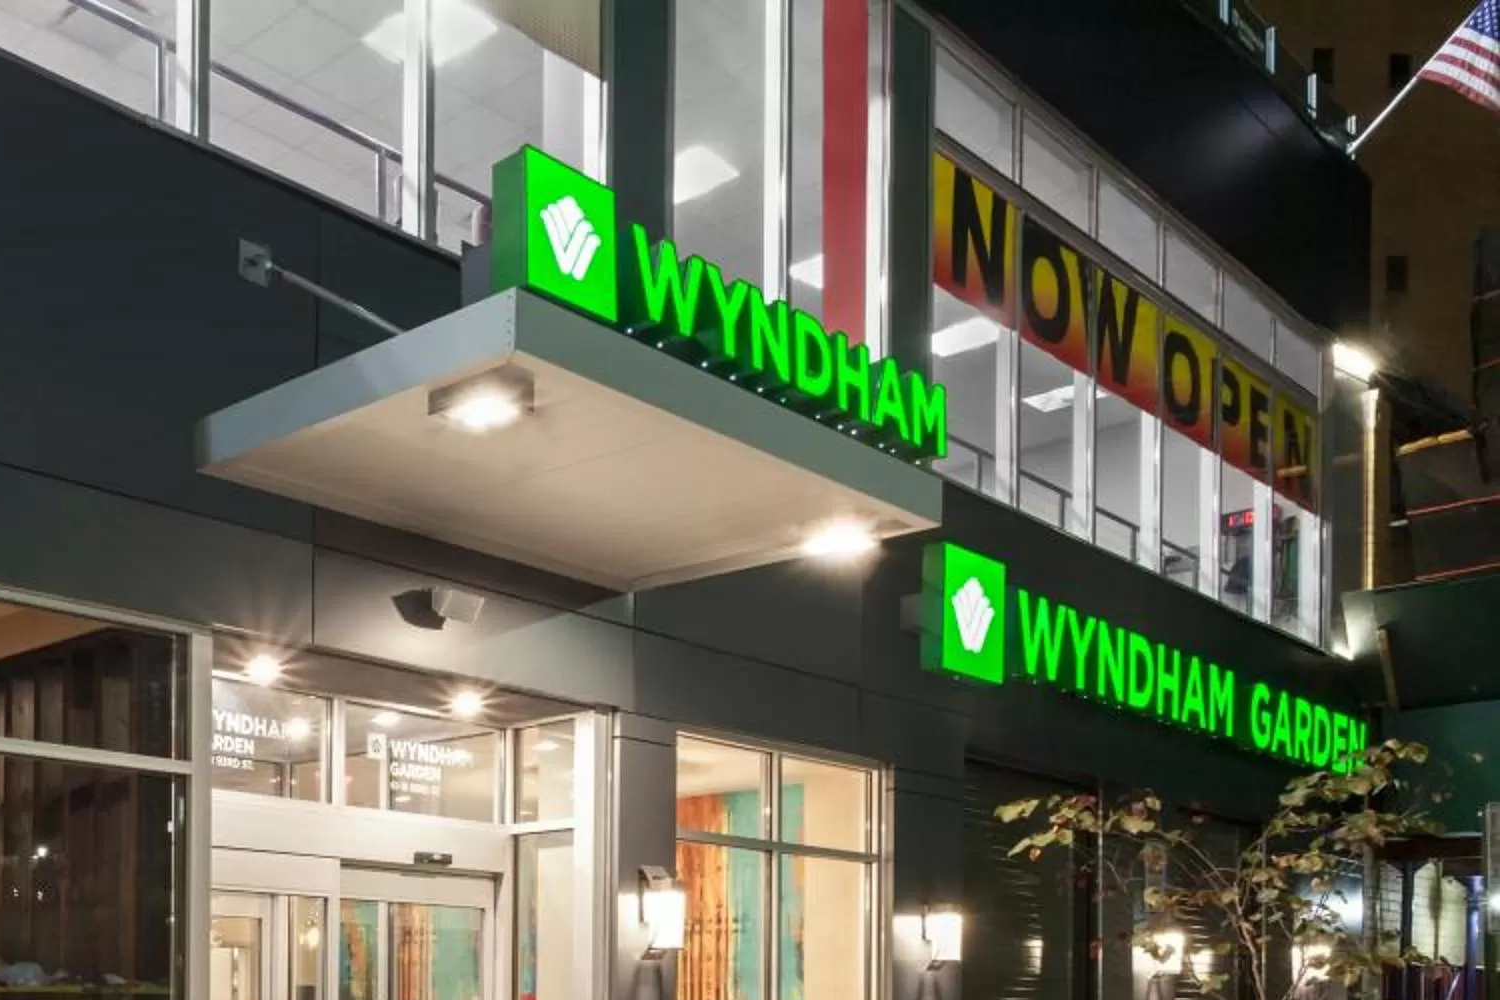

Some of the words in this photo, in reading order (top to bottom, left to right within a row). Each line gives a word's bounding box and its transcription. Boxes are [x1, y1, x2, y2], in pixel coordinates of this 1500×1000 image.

[630, 222, 948, 457] WYNDHAM
[951, 167, 1140, 386] NOW
[1163, 331, 1314, 494] OPEN
[211, 709, 308, 740] YNDHA
[211, 733, 255, 755] RDEN
[1018, 589, 1234, 737] WYNDHAM
[1250, 682, 1367, 775] GARDEN
